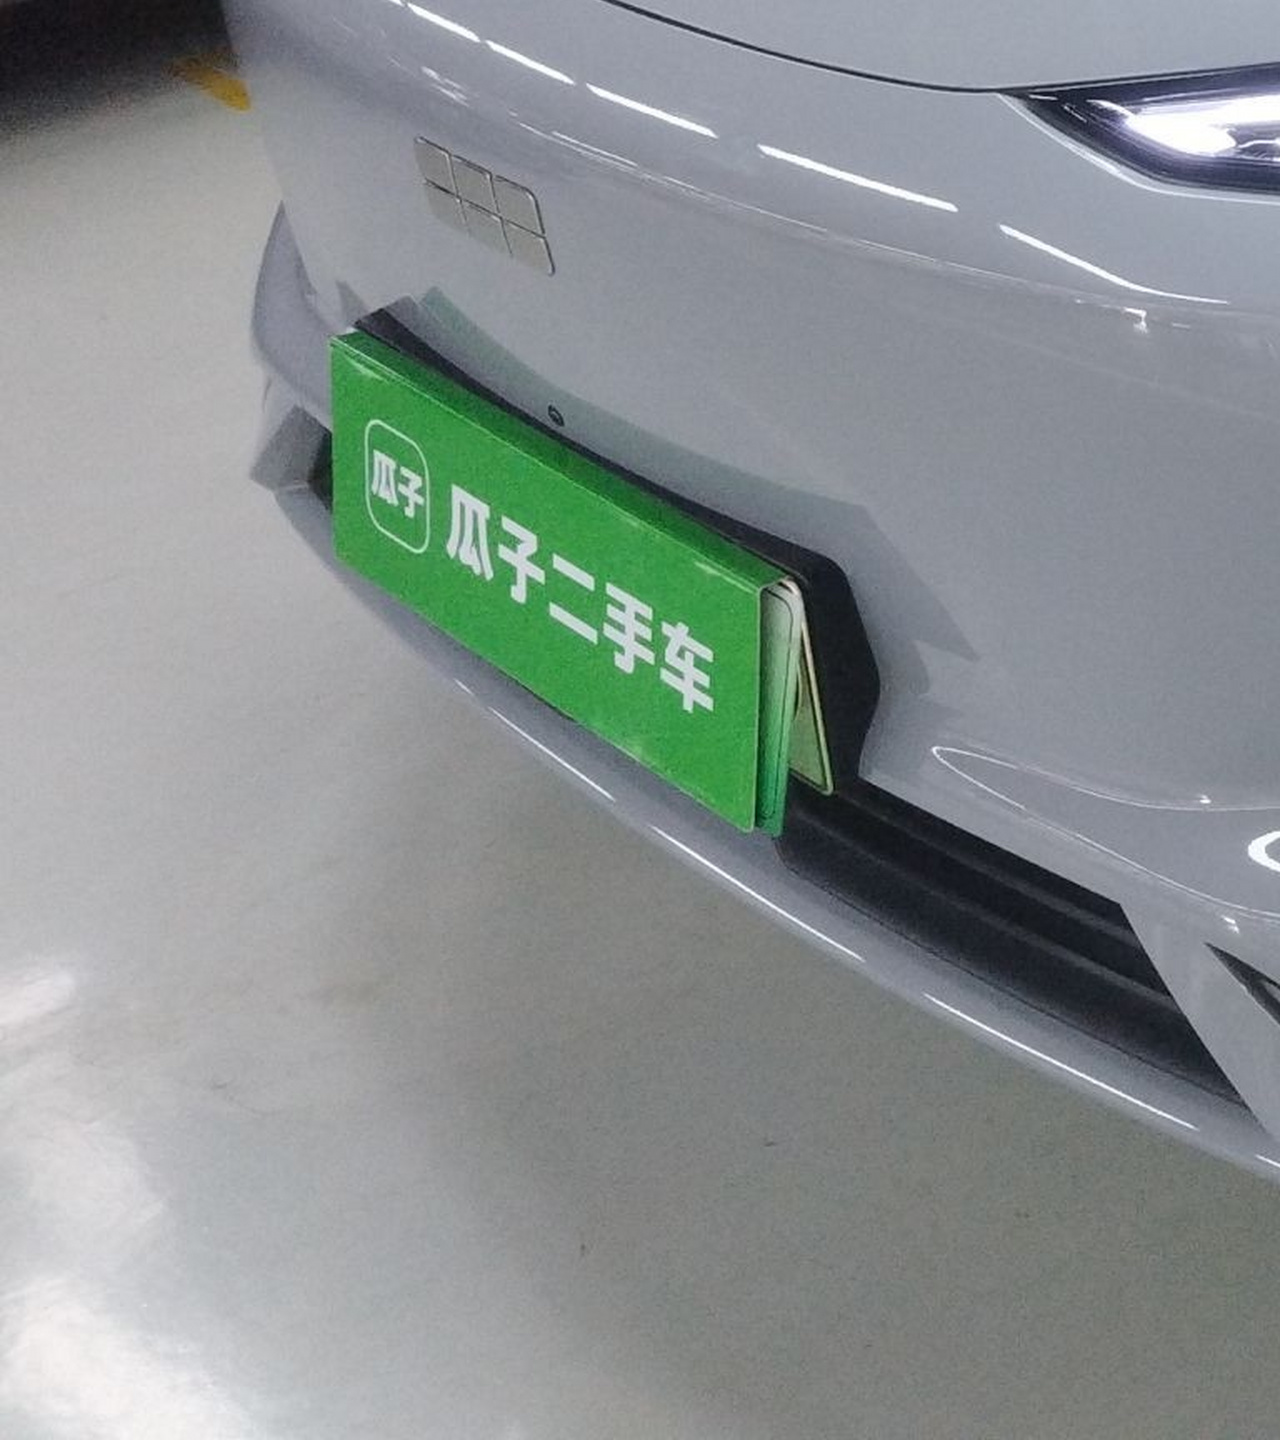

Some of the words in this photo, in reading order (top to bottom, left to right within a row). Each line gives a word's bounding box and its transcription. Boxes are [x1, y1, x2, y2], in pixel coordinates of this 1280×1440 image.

[370, 449, 425, 519] 瓜子
[445, 483, 715, 714] 瓜子二手车
